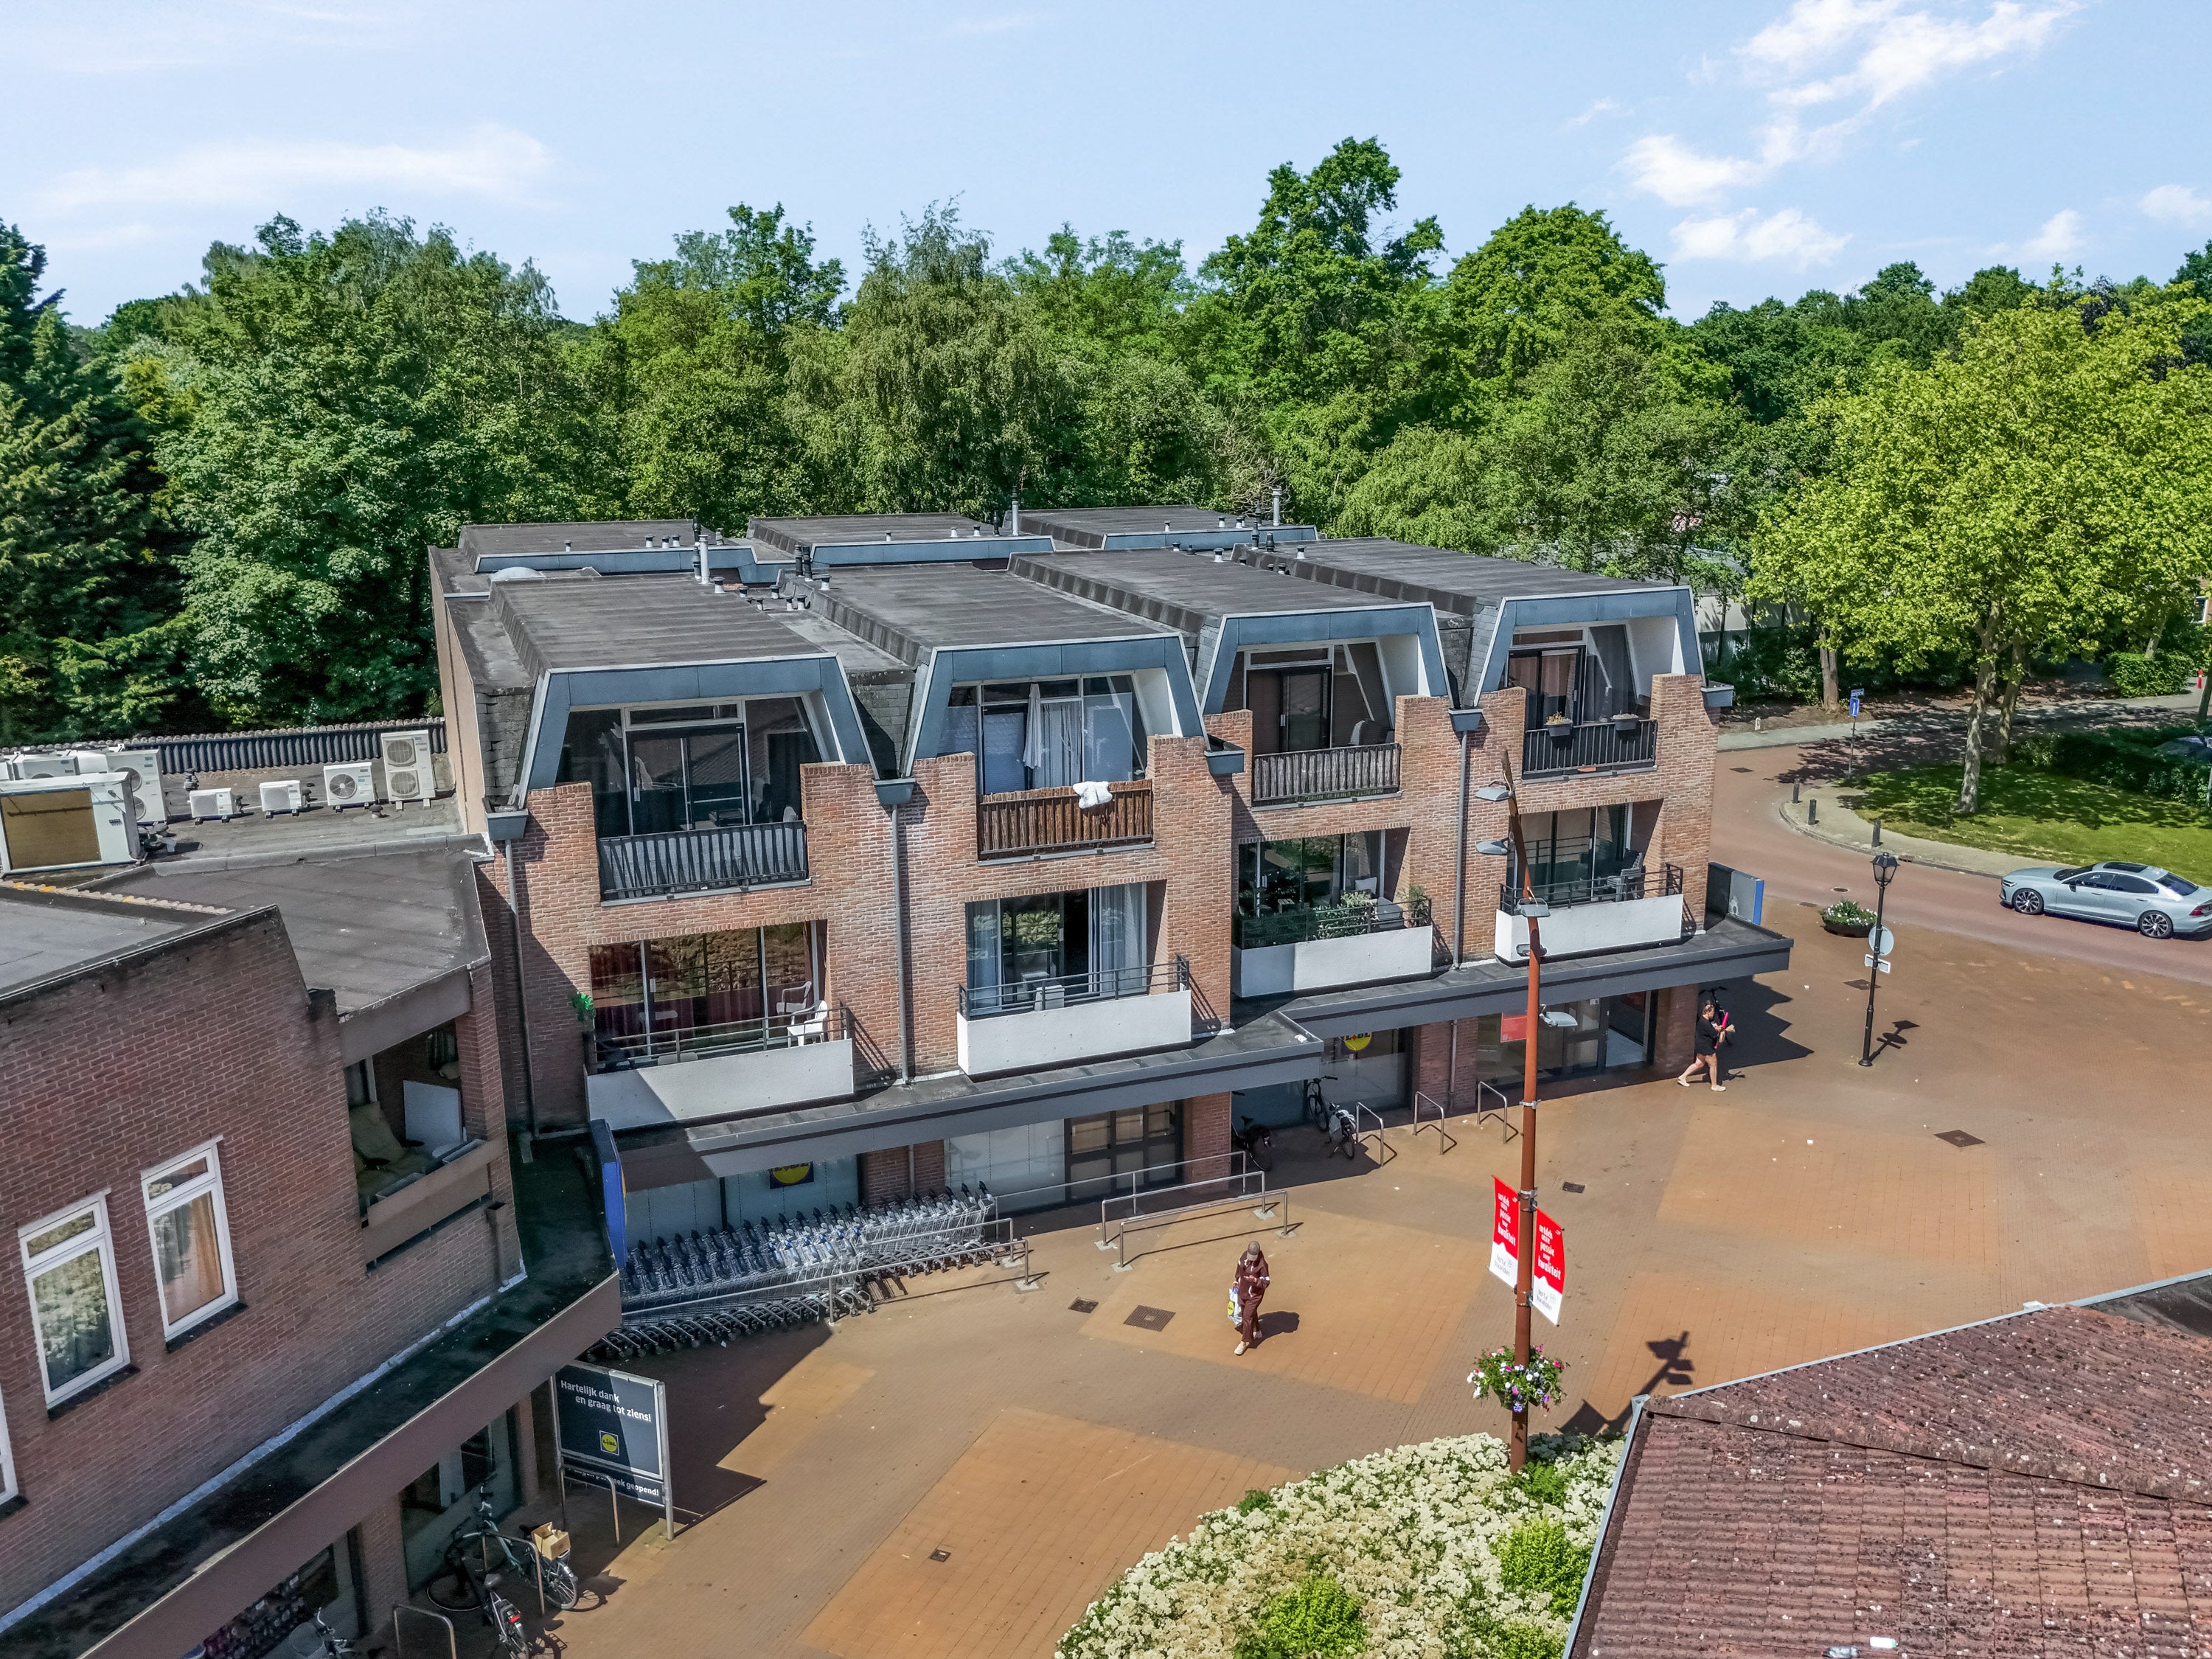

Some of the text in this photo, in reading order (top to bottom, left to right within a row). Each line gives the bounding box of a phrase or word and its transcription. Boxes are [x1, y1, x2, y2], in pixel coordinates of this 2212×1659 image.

[1498, 1222, 1516, 1247] kwaliteit
[1540, 1241, 1554, 1256] passie
[1537, 1255, 1561, 1281] kwaliteit
[560, 1380, 620, 1403] Hartelijk dank
[575, 1395, 652, 1422] en graag tot ziens!
[626, 1483, 659, 1496] geopend!
